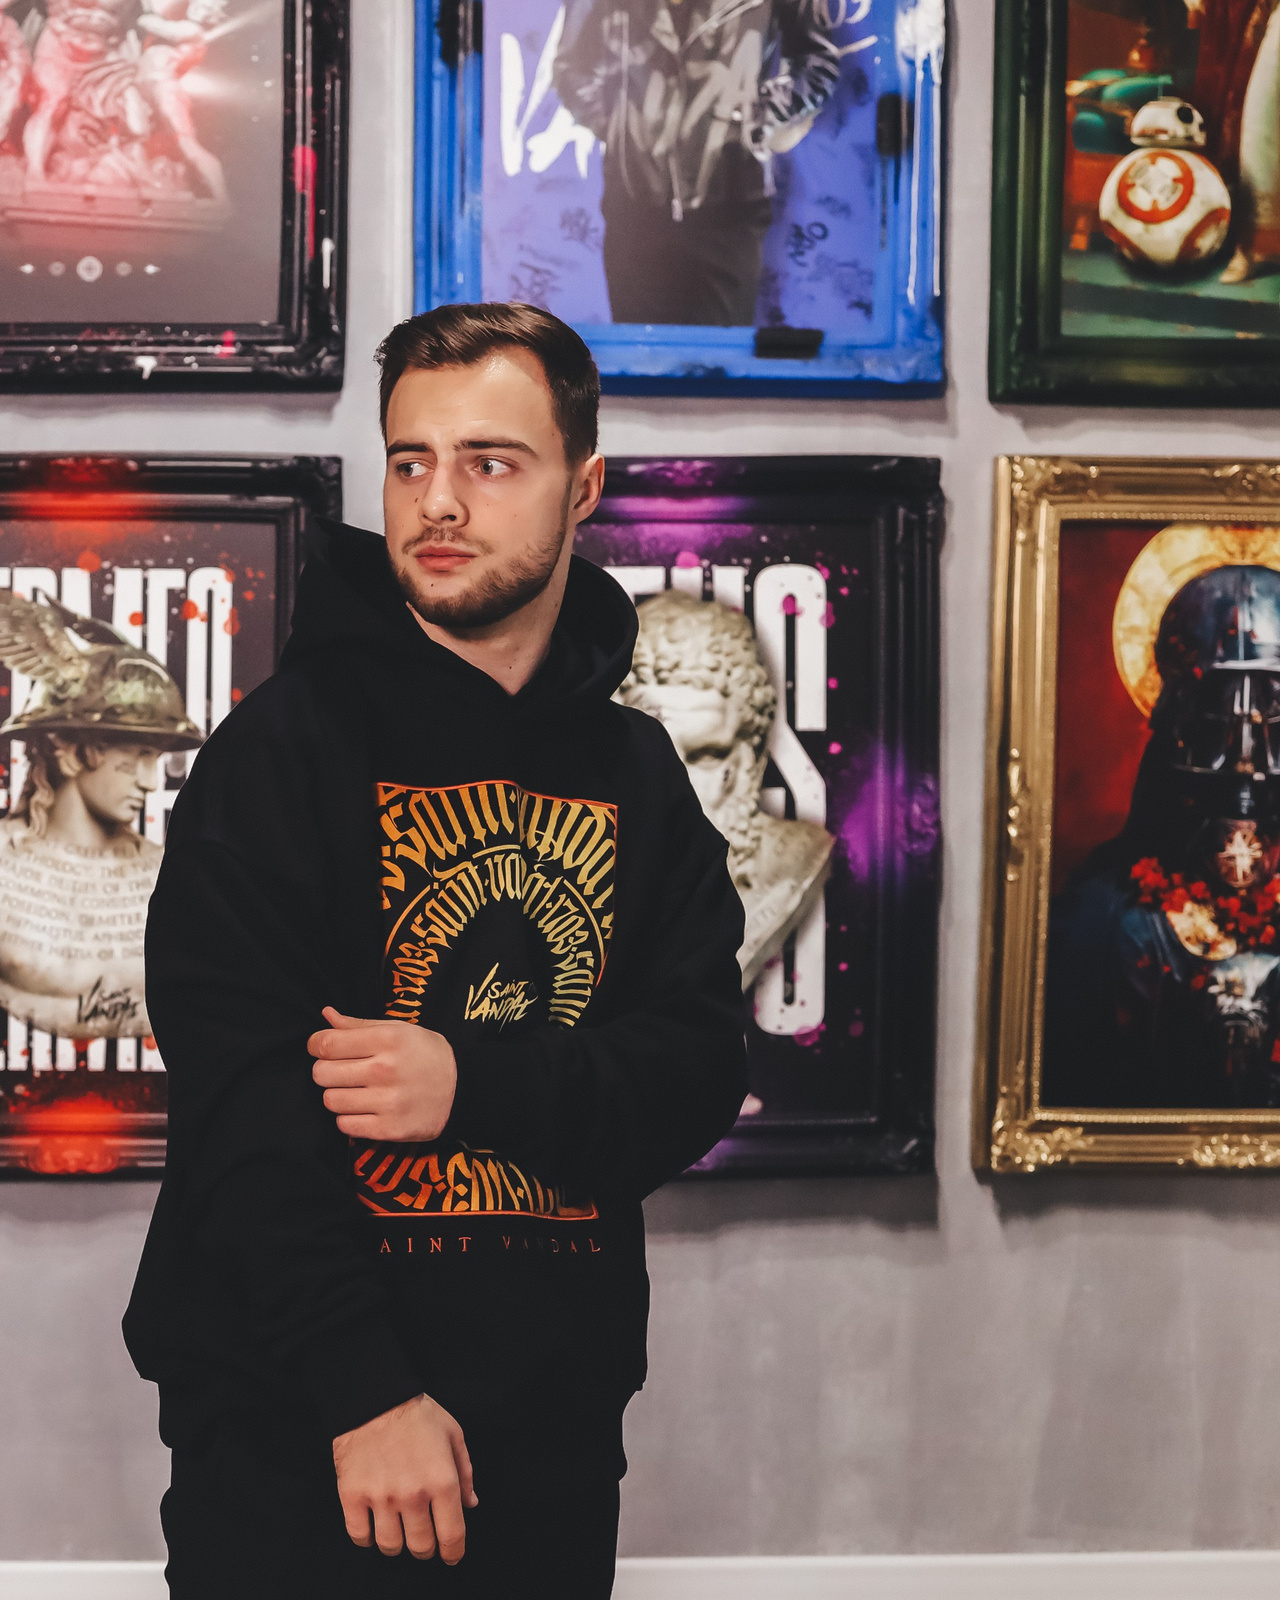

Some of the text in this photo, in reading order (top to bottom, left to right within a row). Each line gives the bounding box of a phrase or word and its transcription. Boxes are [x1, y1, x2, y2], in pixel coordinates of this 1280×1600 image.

[465, 962, 539, 1032] VANDAL
[487, 979, 529, 999] SAINT
[379, 1236, 472, 1253] AINT
